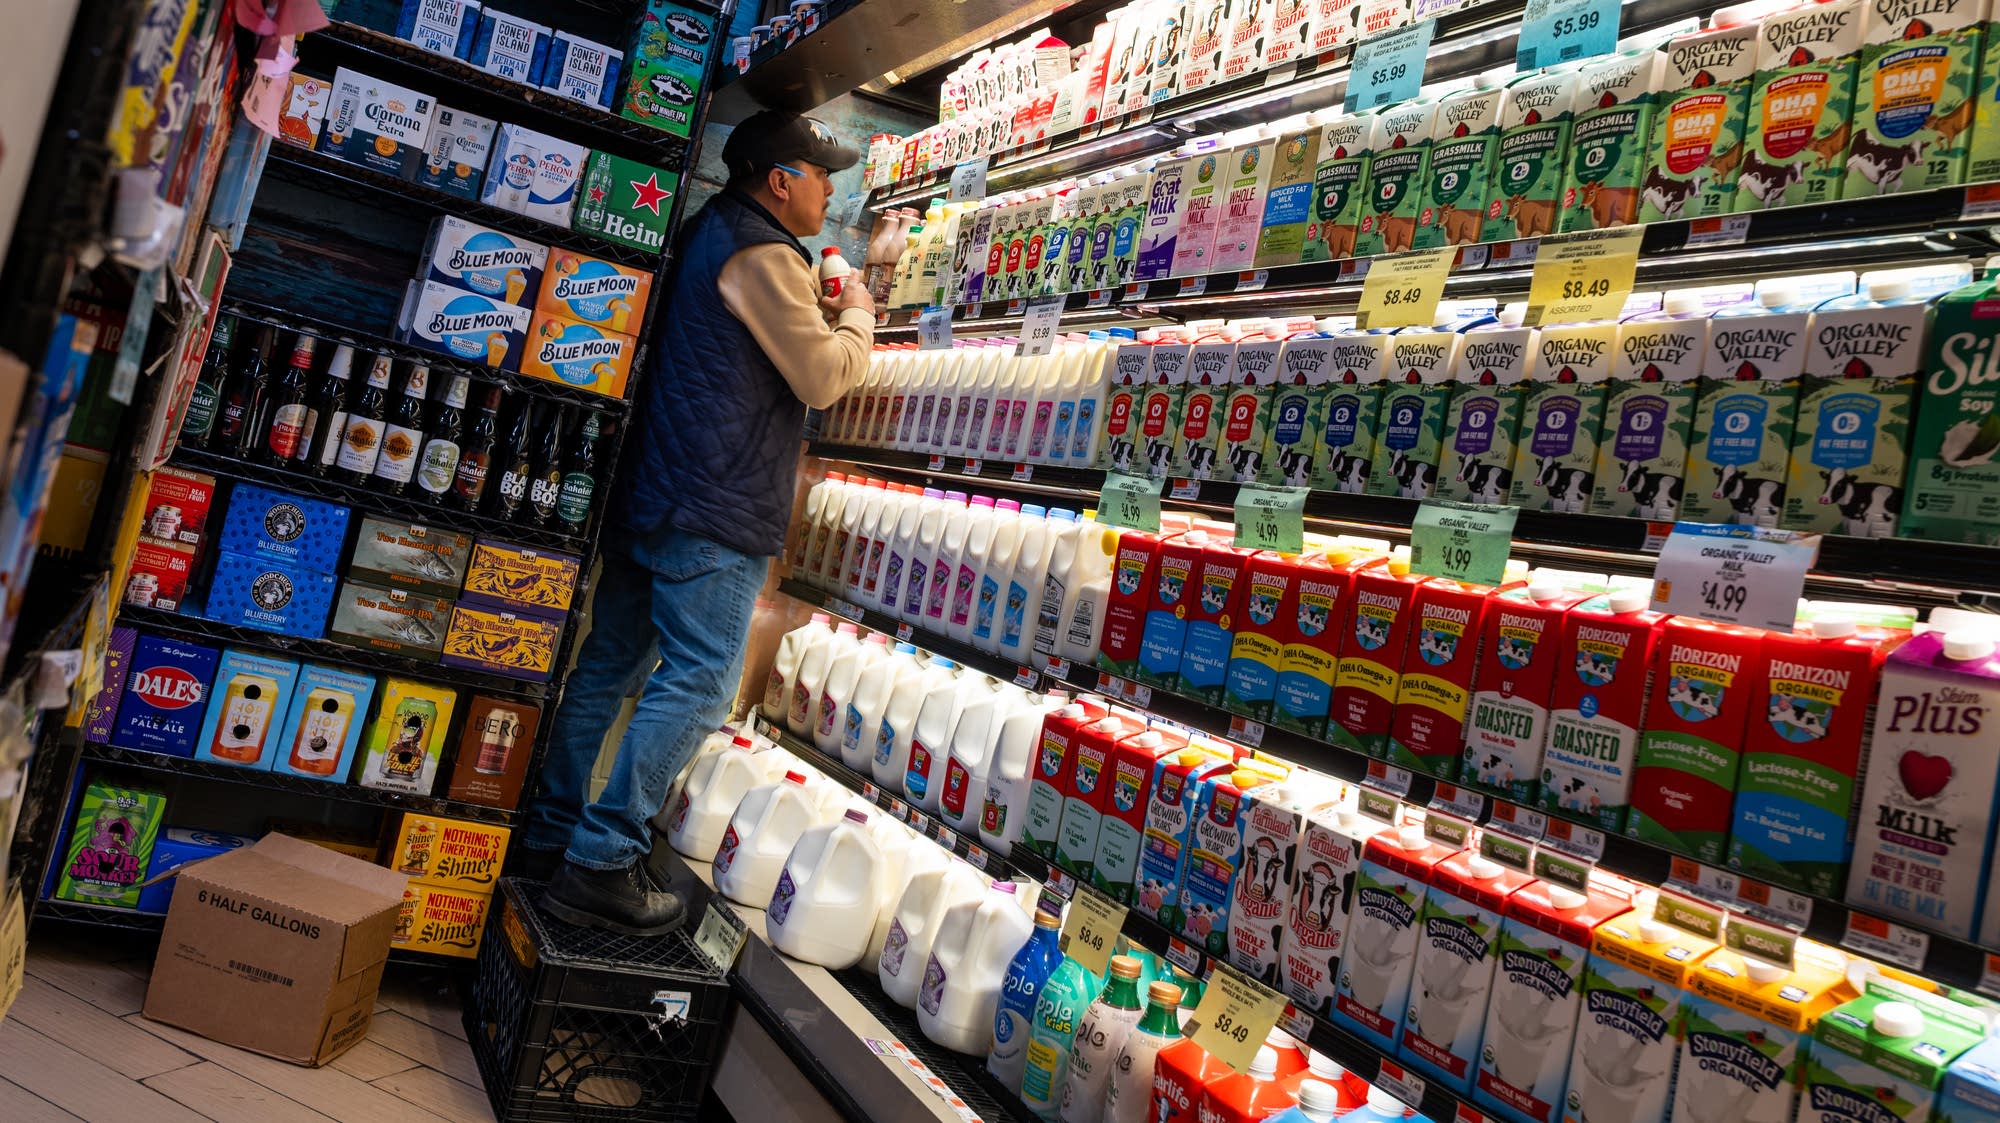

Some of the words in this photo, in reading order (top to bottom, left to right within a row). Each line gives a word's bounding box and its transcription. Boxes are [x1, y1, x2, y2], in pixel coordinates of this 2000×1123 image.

[1364, 7, 1398, 25] WHOLE
[1366, 17, 1391, 32] MILK
[1552, 11, 1600, 40] $5.99
[499, 23, 529, 42] CONEY
[1314, 25, 1344, 42] WHOLE
[1767, 9, 1851, 44] ORGANIC
[496, 34, 530, 54] ISLAND
[1315, 35, 1338, 48] MILK
[1771, 27, 1840, 53] VALLEY
[571, 46, 601, 64] CONEY
[1672, 36, 1749, 66] ORGANIC
[1916, 47, 1944, 60] First
[491, 54, 526, 74] MERMAN
[499, 65, 515, 79] IPA
[569, 58, 602, 77] ISLAND
[1676, 51, 1738, 77] VALLEY
[1371, 63, 1407, 87] $5.99
[1883, 66, 1937, 90] DHA
[564, 76, 598, 97] MERMAN
[572, 87, 587, 101] IPA
[1516, 84, 1561, 105] ORGANIC
[1518, 95, 1555, 112] VALLEY
[1770, 91, 1818, 113] DHA
[365, 102, 421, 132] Corona
[651, 103, 659, 113] 60
[676, 109, 687, 122] IPA
[1673, 112, 1717, 131] DHA
[377, 121, 404, 138] Extra
[1577, 113, 1635, 135] GRASSMILK
[456, 136, 485, 151] Corona
[1503, 127, 1557, 150] GRASSMILK
[462, 145, 477, 156] Extra
[1434, 142, 1484, 161] GRASSMILK
[539, 160, 573, 178] PERONI
[1927, 160, 1949, 176] 12
[1152, 179, 1181, 198] Goat
[1229, 187, 1256, 203] WHOLE
[1149, 196, 1178, 216] Milk
[1229, 202, 1249, 217] MILK
[450, 248, 490, 270] BLUE
[492, 250, 532, 267] MOON
[556, 278, 595, 299] BLUE
[597, 279, 636, 294] MOON
[1384, 288, 1421, 306] $8.49
[1563, 279, 1609, 299] $8.49
[1548, 304, 1591, 315] ASSORTED
[429, 311, 470, 334] BLUE
[473, 313, 513, 329] MOON
[1032, 327, 1050, 340] $3.99
[1715, 329, 1797, 349] ORGANIC
[1819, 323, 1912, 345] ORGANIC
[540, 342, 579, 362] BLUE
[581, 342, 620, 357] MOON
[1543, 339, 1606, 356] ORGANIC
[1719, 346, 1786, 362] VALLEY
[1824, 340, 1900, 360] VALLEY
[1237, 351, 1275, 365] ORGANIC
[1239, 361, 1269, 373] VALLEY
[1546, 353, 1598, 368] VALLEY
[563, 363, 590, 375] MANGO
[564, 369, 589, 380] WHEAT
[1960, 398, 1994, 414] Soy
[1819, 440, 1832, 449] FAT
[1833, 440, 1849, 449] FREE
[1850, 440, 1867, 450] MILK
[173, 469, 197, 480] ORANGE
[189, 494, 206, 504] FRUIT
[191, 488, 206, 498] REAL
[1121, 503, 1140, 522] $4.99
[1256, 522, 1278, 543] $4.99
[1439, 517, 1467, 530] ORGANIC
[1468, 521, 1490, 532] VALLEY
[257, 540, 299, 556] BLUEBERRY
[377, 531, 396, 544] Two
[398, 536, 434, 553] Hearted
[437, 544, 453, 556] IPA
[506, 558, 545, 574] Hearted
[1442, 548, 1471, 572] $4.99
[1701, 547, 1742, 561] ORGANIC
[1744, 551, 1776, 565] VALLEY
[1722, 561, 1743, 572] MILK
[254, 571, 292, 593] WOODCHUCK
[1300, 580, 1339, 599] HORIZON
[1302, 594, 1330, 607] ORGANIC
[1701, 581, 1747, 614] $4.99
[245, 608, 287, 625] BLUEBERRY
[1422, 603, 1471, 625] HORIZON
[1425, 620, 1460, 634] ORGANIC
[1670, 644, 1741, 673] HORIZON
[1676, 665, 1726, 683] ORGANIC
[1768, 660, 1850, 690] HORIZON
[134, 672, 203, 702] DALE'S
[1402, 679, 1420, 690] DHA
[1421, 681, 1462, 705] Omega-3
[1776, 681, 1834, 701] ORGANIC
[1938, 686, 1980, 706] Skim
[231, 714, 261, 728] WTR
[1475, 704, 1533, 740] GRASSFED
[1887, 693, 1984, 735] Plus
[132, 717, 160, 730] PALE
[163, 722, 185, 734] ALE
[475, 716, 526, 739] BERO
[1648, 738, 1728, 767] Lactose-Free
[1748, 760, 1839, 792] Lactose-Free
[1201, 821, 1236, 845] GROWING
[1435, 823, 1461, 839] ORGANIC
[1876, 804, 1957, 846] Milk
[407, 833, 436, 845] Shiner
[443, 828, 501, 849] NOTHING'S
[1205, 839, 1224, 856] YEARS
[1308, 830, 1350, 864] Farmland
[440, 842, 464, 856] FINER
[466, 846, 489, 860] THAN
[491, 852, 497, 860] A
[433, 857, 498, 879] Shiner
[427, 892, 485, 914] NOTHING'S
[1361, 889, 1412, 921] Stonyfield
[198, 890, 207, 903] 6
[210, 897, 249, 916] HALF
[251, 906, 321, 940] GALLONS
[424, 907, 449, 920] FINER
[450, 911, 472, 924] THAN
[474, 916, 481, 924] A
[1364, 906, 1402, 931] ORGANIC
[1675, 910, 1712, 932] ORGANIC
[417, 922, 481, 945] Shiner
[1290, 906, 1340, 949] Organic
[1079, 926, 1103, 951] $8.49
[1287, 955, 1322, 980] WHOLE
[1506, 952, 1568, 991] Stonyfield
[1289, 969, 1315, 990] MILK
[1510, 974, 1556, 1001] ORGANIC
[1045, 1016, 1072, 1034] kids
[1215, 1014, 1248, 1043] $8.49
[1692, 1034, 1778, 1081] Stonyfield
[1699, 1059, 1763, 1093] ORGANIC
[1490, 1079, 1513, 1100] WHOLE
[1515, 1091, 1533, 1108] MILK
